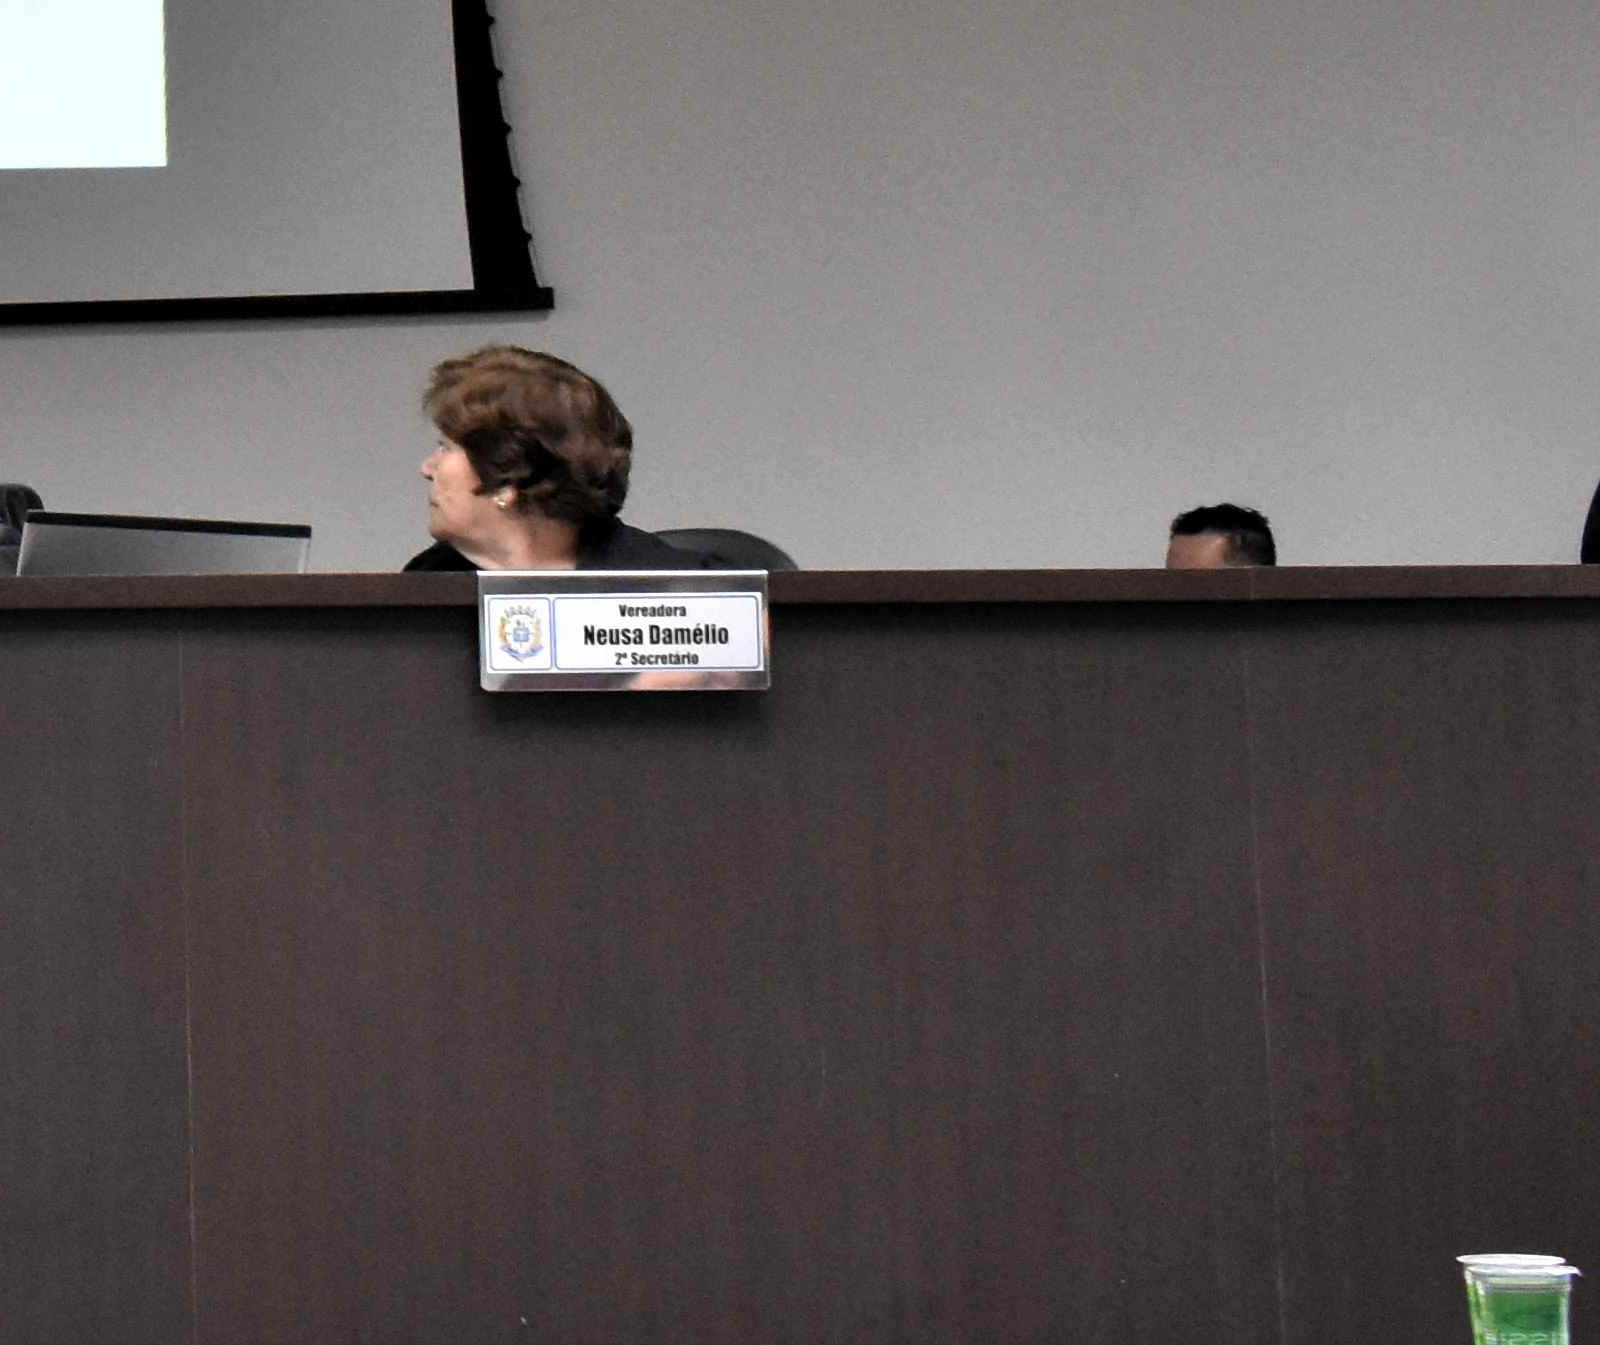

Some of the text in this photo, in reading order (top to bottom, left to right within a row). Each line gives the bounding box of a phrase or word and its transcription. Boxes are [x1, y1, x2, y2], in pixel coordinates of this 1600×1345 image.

[618, 603, 687, 617] Vereadora
[583, 622, 730, 645] Neusa Damélio
